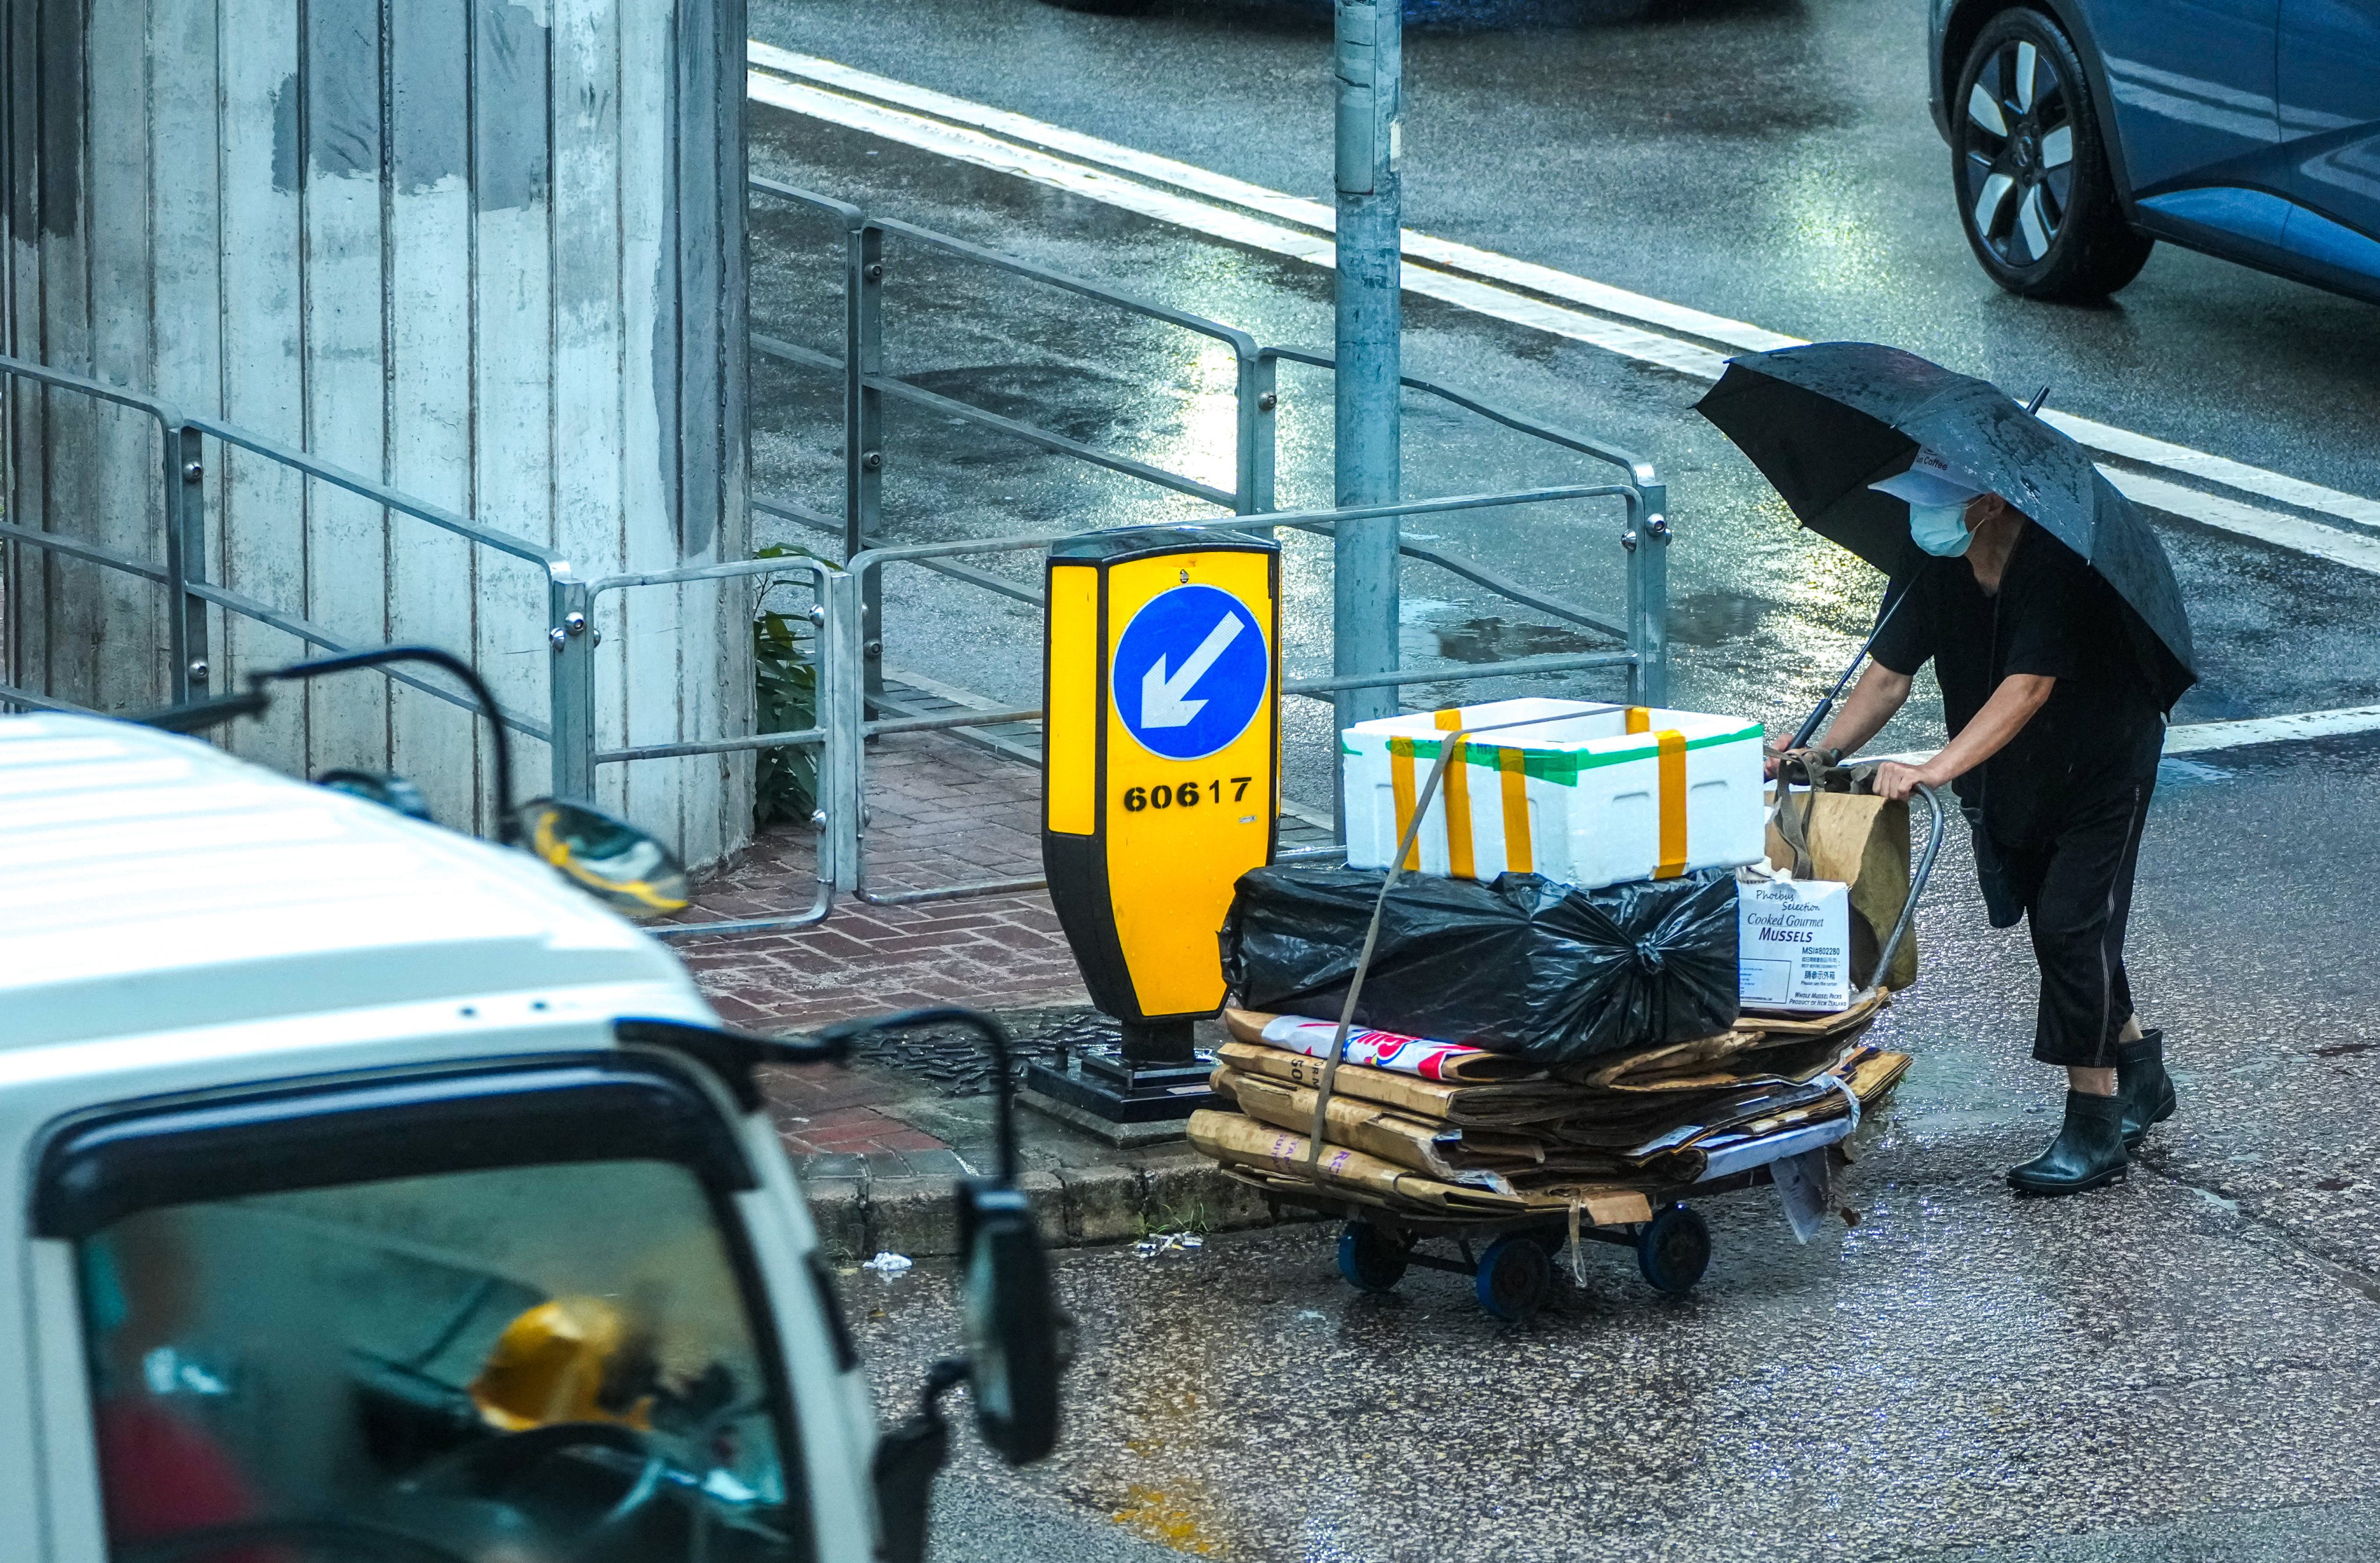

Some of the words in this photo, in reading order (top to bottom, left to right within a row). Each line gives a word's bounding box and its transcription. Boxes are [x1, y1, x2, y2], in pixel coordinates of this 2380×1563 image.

[1924, 456, 1948, 471] Coffee
[1123, 776, 1252, 812] 60617
[1756, 890, 1794, 901] Phoebus
[1782, 901, 1820, 912] Selection
[1748, 913, 1784, 926] Cooked
[1786, 915, 1824, 927] Gourmet
[1759, 927, 1813, 942] MUSSELS
[1802, 947, 1840, 955] MSI#802280
